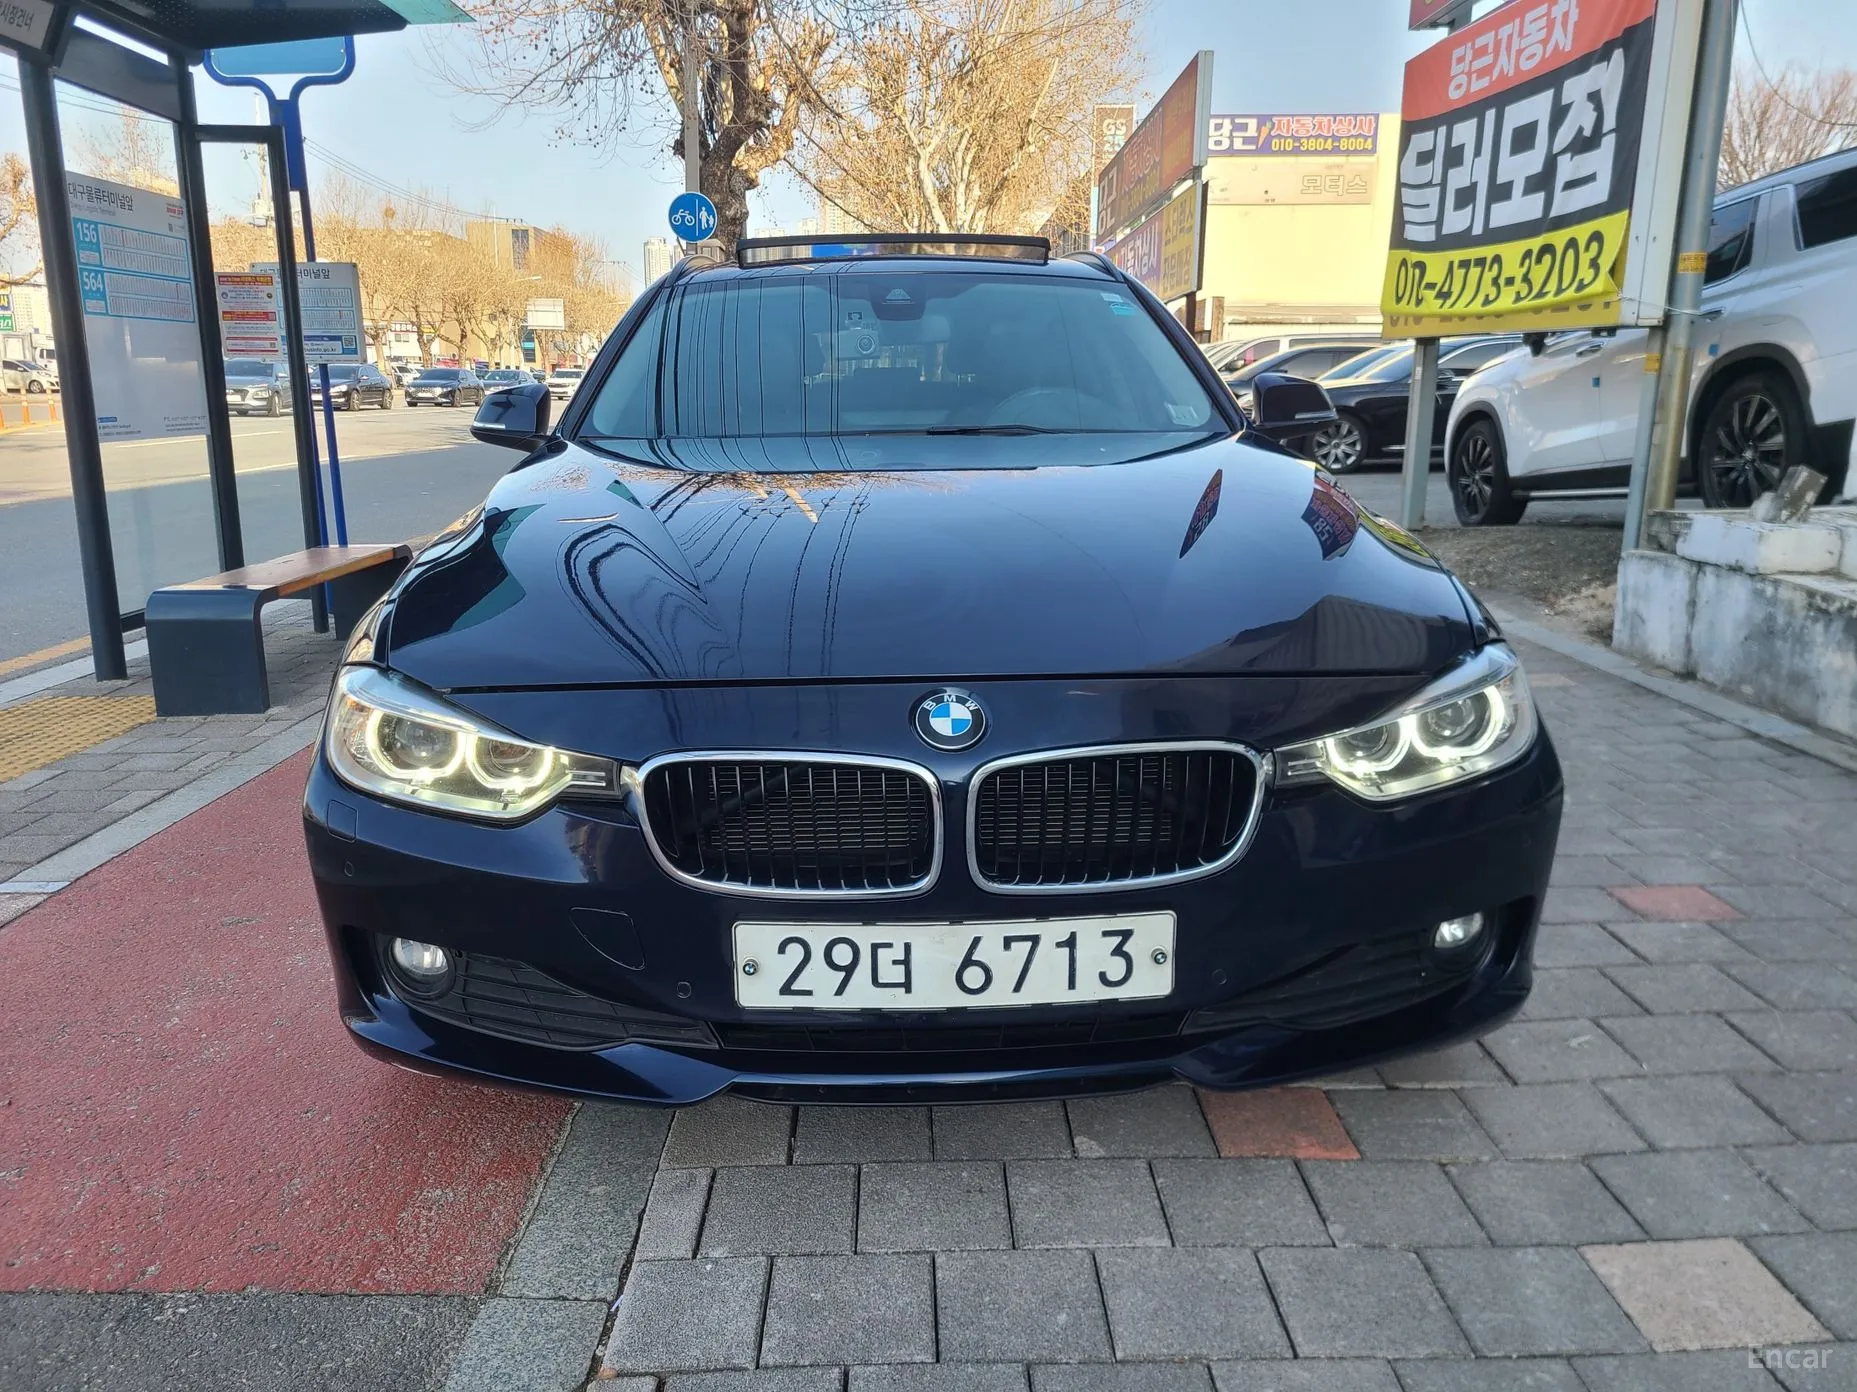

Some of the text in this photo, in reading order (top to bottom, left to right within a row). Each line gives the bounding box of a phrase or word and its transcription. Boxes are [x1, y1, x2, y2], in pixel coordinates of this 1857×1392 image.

[1448, 0, 1579, 100] 당근자동차
[1208, 118, 1258, 150] 당근
[1271, 116, 1376, 137] 자동차상사
[1271, 138, 1373, 151] 010-3804-8004
[1400, 47, 1625, 242] 딜러모집
[1300, 174, 1368, 196] 모터스
[68, 182, 134, 212] 대구물류터미널앞
[77, 222, 97, 242] 156
[83, 271, 104, 292] 564
[923, 695, 979, 711] BMW
[777, 929, 1135, 997] 29더 6713
